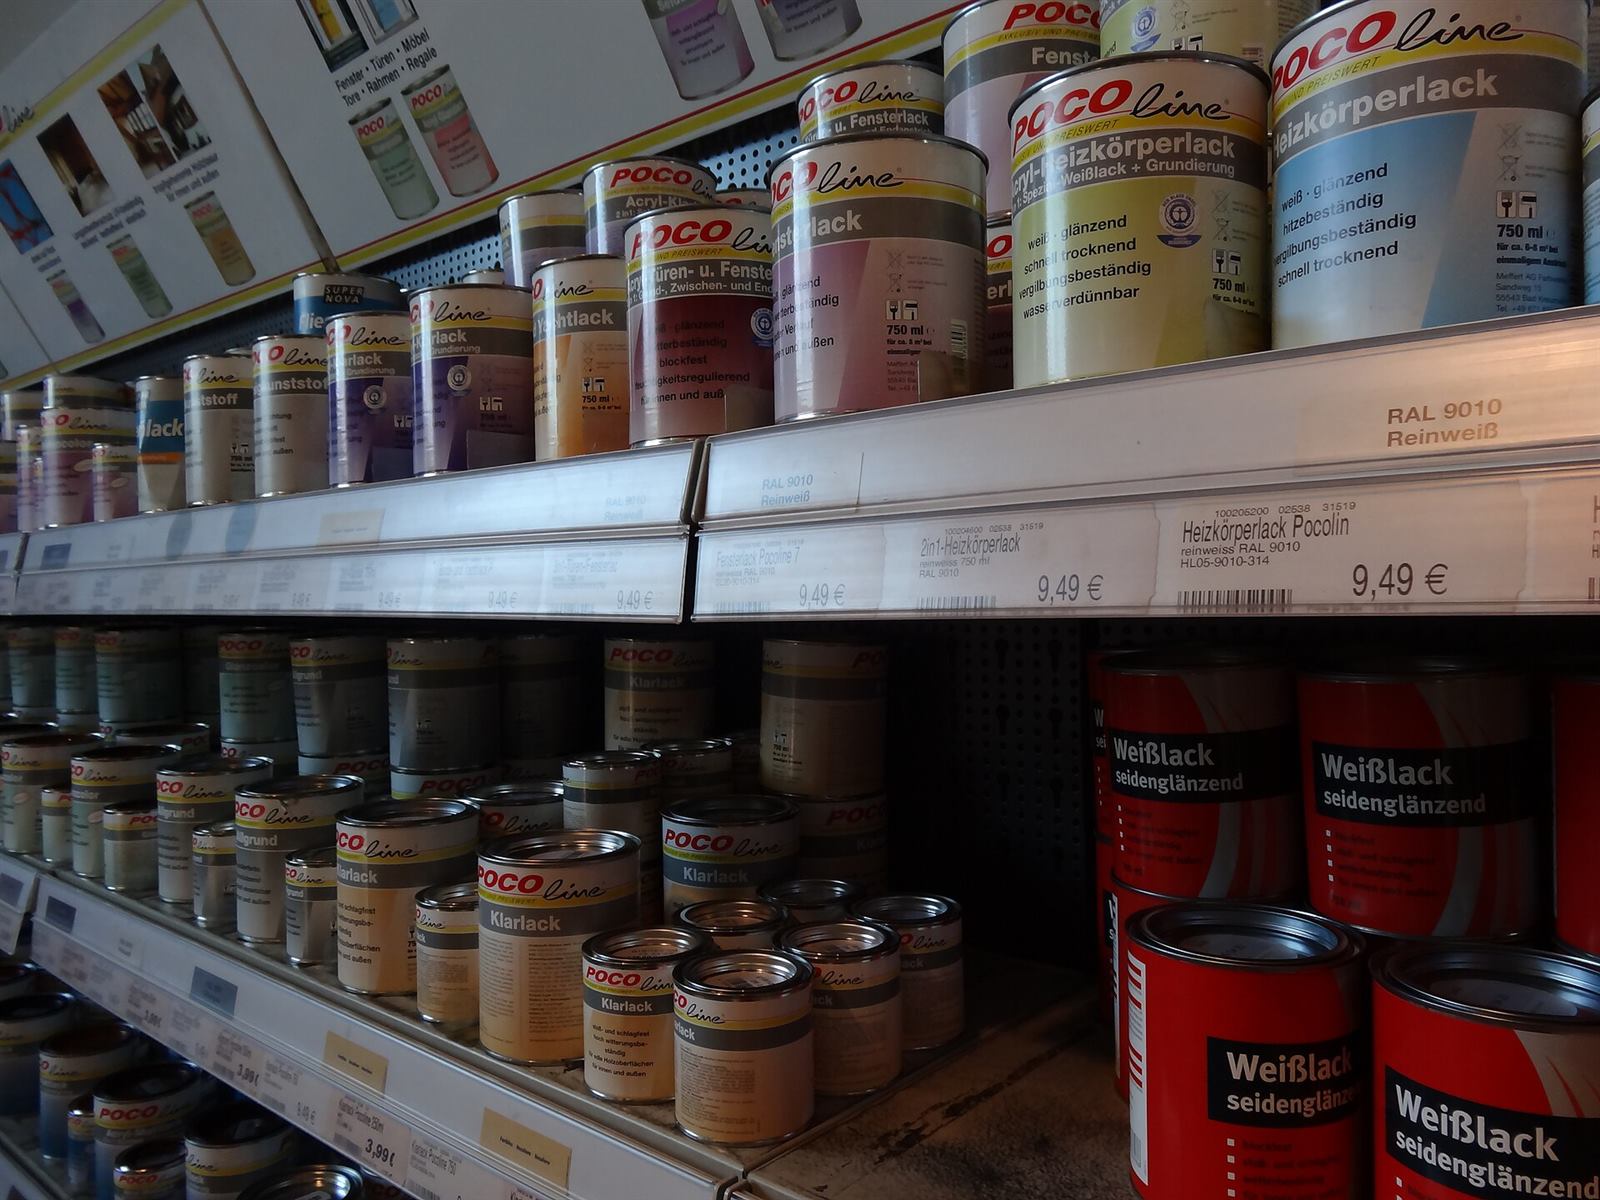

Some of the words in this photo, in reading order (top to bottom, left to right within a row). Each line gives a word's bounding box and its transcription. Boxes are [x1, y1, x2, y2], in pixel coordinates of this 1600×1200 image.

[335, 69, 364, 92] Fenster
[370, 49, 396, 72] Türen
[401, 28, 430, 53] Möbel
[342, 92, 361, 108] Tore
[366, 67, 400, 95] Rahmen
[405, 47, 438, 72] Regale
[1310, 56, 1381, 95] PREISWERT
[411, 84, 443, 110] POCO
[850, 111, 929, 128] Fensterlack
[1013, 80, 1132, 157] POCO
[1273, 68, 1498, 160] Heizkörperlack
[357, 116, 384, 139] POCO
[609, 165, 692, 190] POCO
[1146, 156, 1236, 178] Grundierung
[1281, 190, 1303, 213] weiß
[1313, 163, 1388, 199] glänzend
[1283, 192, 1384, 236] hitzebeständig
[630, 219, 733, 260] POCO
[1028, 233, 1051, 252] weiß
[1061, 215, 1128, 240] glänzend
[1497, 223, 1523, 239] 750
[1527, 223, 1544, 239] ml
[671, 247, 723, 259] PREISWERT
[1024, 252, 1058, 275] schnell
[1061, 238, 1137, 262] trocknend
[1278, 261, 1310, 288] schnell
[1313, 241, 1399, 272] trocknend
[699, 265, 715, 278] u.
[1019, 261, 1152, 300] vergilbungsbeständig
[325, 286, 364, 296] SUPER
[670, 281, 728, 294] Zwischen-
[730, 281, 752, 291] und
[1212, 278, 1232, 292] 750
[1234, 281, 1246, 293] ml
[325, 294, 361, 304] NOVA
[1023, 287, 1140, 320] wasserverdünnbar
[674, 319, 725, 333] glänzend
[886, 325, 907, 335] 750
[910, 325, 924, 335] ml
[659, 355, 708, 368] blockfest
[582, 395, 597, 403] 750
[679, 390, 700, 400] und
[702, 388, 725, 401] auß
[1388, 405, 1436, 425] RAL
[1443, 398, 1502, 419] 9010
[1387, 422, 1499, 447] Reinweiß
[761, 478, 784, 490] RAL
[787, 474, 814, 488] 9010
[760, 490, 811, 506] Reinweiß
[1215, 506, 1270, 518] 100205200
[1322, 501, 1357, 512] 31519
[1182, 516, 1287, 546] Heizkörperlack
[1292, 512, 1350, 538] Pocolin
[920, 532, 1021, 560] 2in1-Heizkörperlack
[1181, 544, 1235, 557] reinweiss
[1239, 543, 1266, 554] RAL
[1269, 541, 1301, 552] 9010
[919, 569, 936, 578] RAL
[960, 557, 976, 566] 750
[1180, 555, 1270, 569] HL05-9010-314
[1037, 574, 1080, 606] 9,49
[1087, 574, 1104, 601] €
[1352, 564, 1414, 602] 9,49
[1424, 563, 1449, 595] €
[616, 590, 641, 612] 9,49
[799, 583, 829, 610] 9,49
[834, 583, 846, 606] €
[610, 647, 673, 662] POCO
[1113, 735, 1216, 767] Weißlack
[1321, 752, 1457, 786] Weißlack
[1115, 770, 1244, 795] seidenglänzend
[1323, 789, 1487, 818] seidenglänzend
[665, 828, 734, 852] POCO
[478, 864, 543, 893] POCO
[683, 867, 749, 883] Klarlack
[490, 910, 561, 932] Klarlack
[585, 966, 640, 986] POCO
[601, 997, 653, 1013] Klarlack
[1226, 1042, 1355, 1085] Weißlack
[100, 1105, 159, 1121] POCO
[1394, 1083, 1560, 1163] Weißlack
[364, 1138, 389, 1163] 3,99
[1395, 1129, 1600, 1200] seidenglänzend
